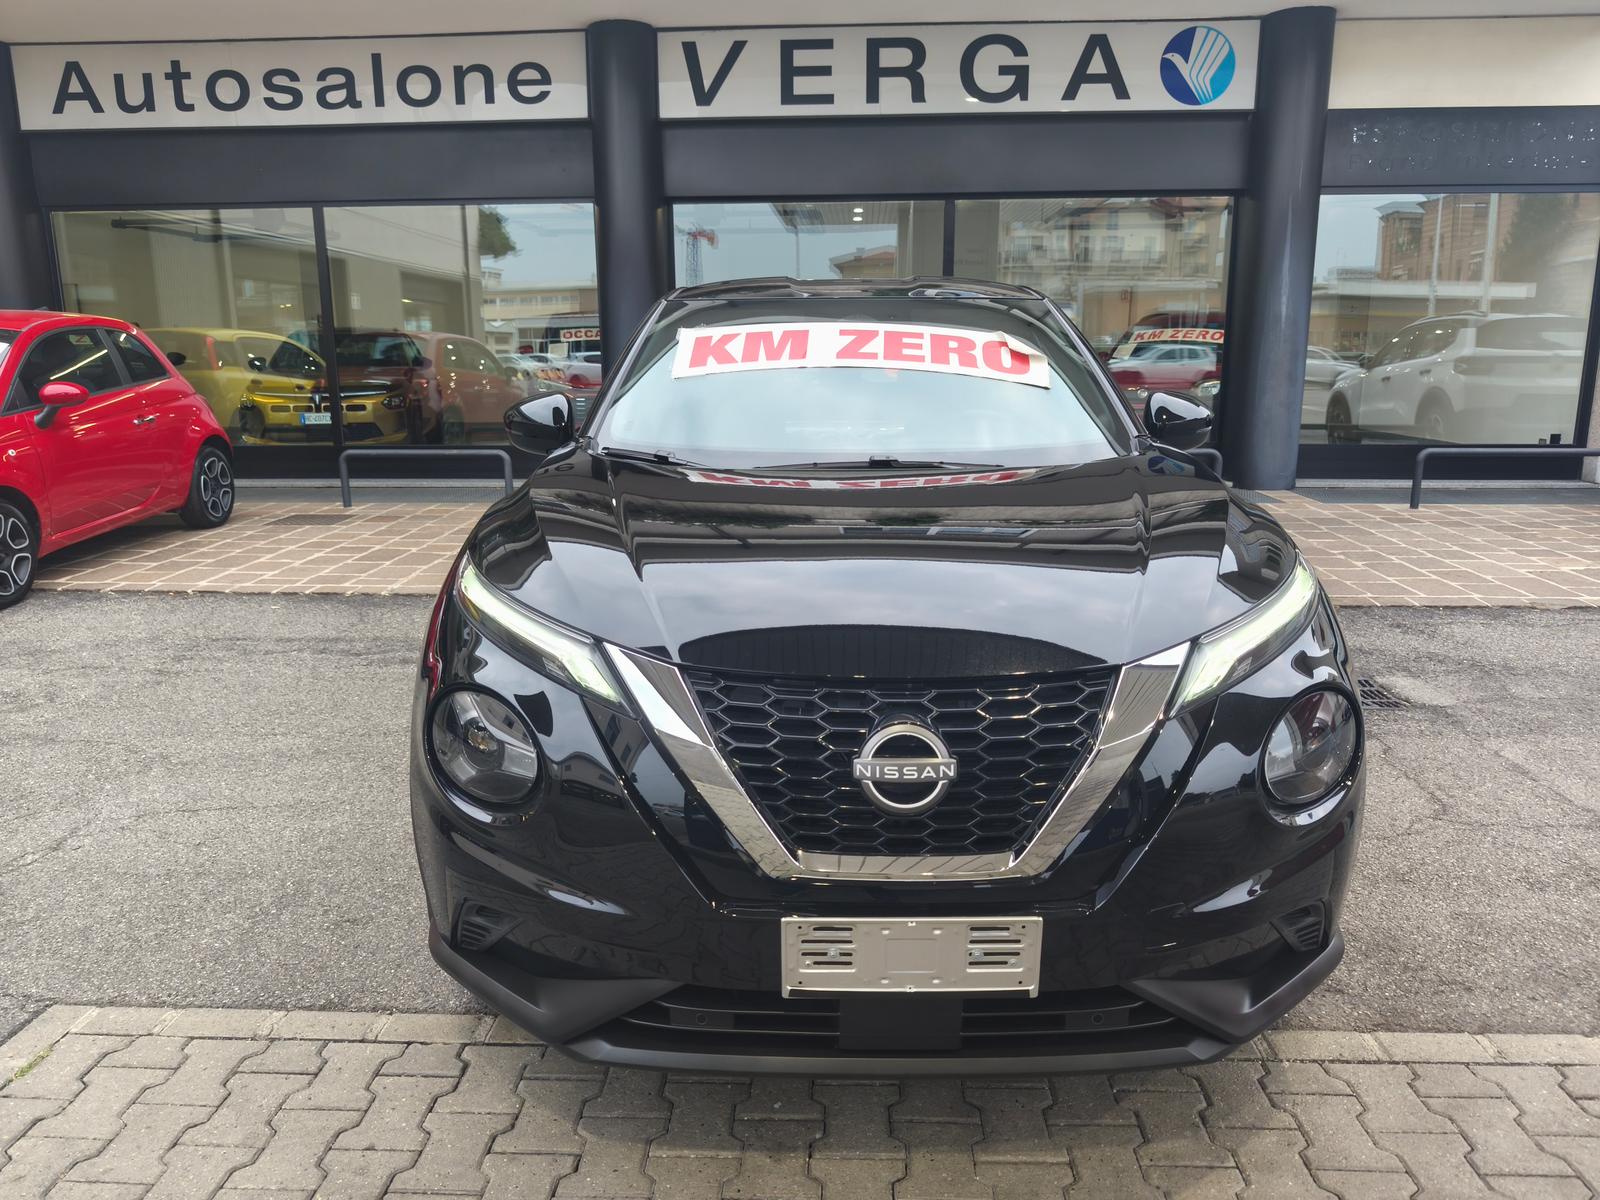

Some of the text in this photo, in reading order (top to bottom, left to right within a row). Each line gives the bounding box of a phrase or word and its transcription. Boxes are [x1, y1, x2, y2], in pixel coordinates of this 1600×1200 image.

[53, 53, 552, 114] Autosalone
[681, 34, 1130, 107] VERGA
[689, 329, 1032, 375] KM ZERO
[1134, 329, 1224, 341] KM ZERO
[856, 764, 954, 778] NISSAN
